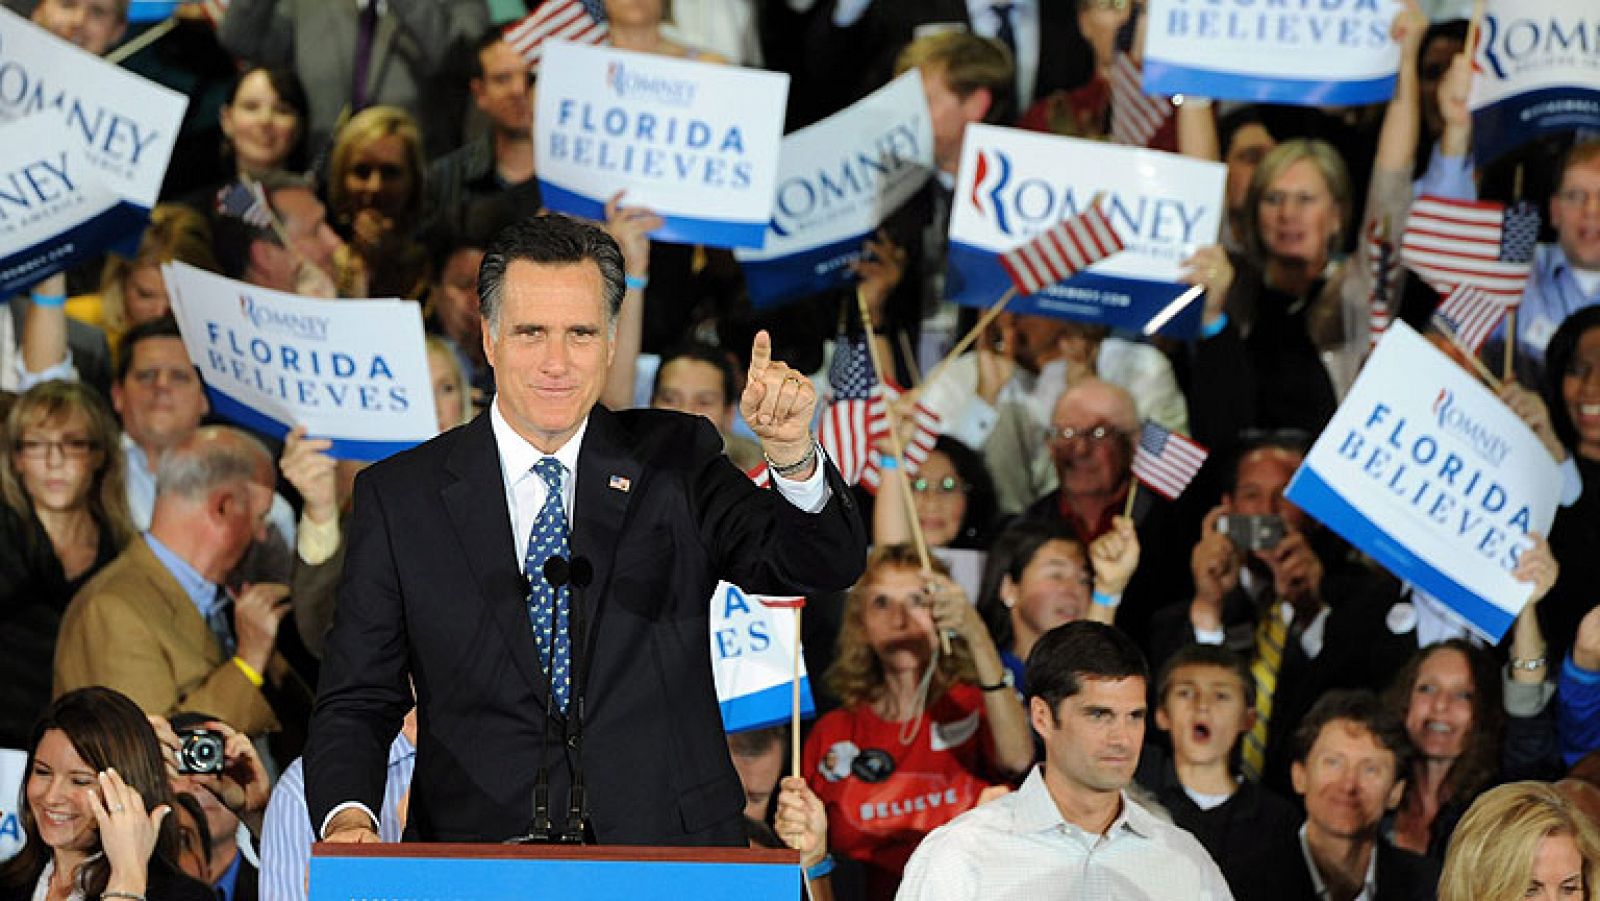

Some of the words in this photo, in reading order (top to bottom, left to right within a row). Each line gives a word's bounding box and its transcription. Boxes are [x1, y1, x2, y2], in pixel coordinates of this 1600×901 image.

[1167, 8, 1388, 47] BELIEVES
[1473, 13, 1600, 79] ROM
[0, 59, 159, 164] OMNEY
[557, 98, 744, 154] FLORIDA
[550, 132, 753, 188] BELIEVES
[769, 114, 920, 237] OMNEY
[240, 295, 330, 336] ROMNEY
[207, 321, 393, 380] FLORIDA
[208, 349, 410, 412] BELIEVES
[1432, 386, 1513, 461] ROMNEY
[1366, 402, 1531, 535] FLORIDA
[1338, 430, 1521, 572] BELIEVES
[859, 787, 958, 821] BELIEVE
